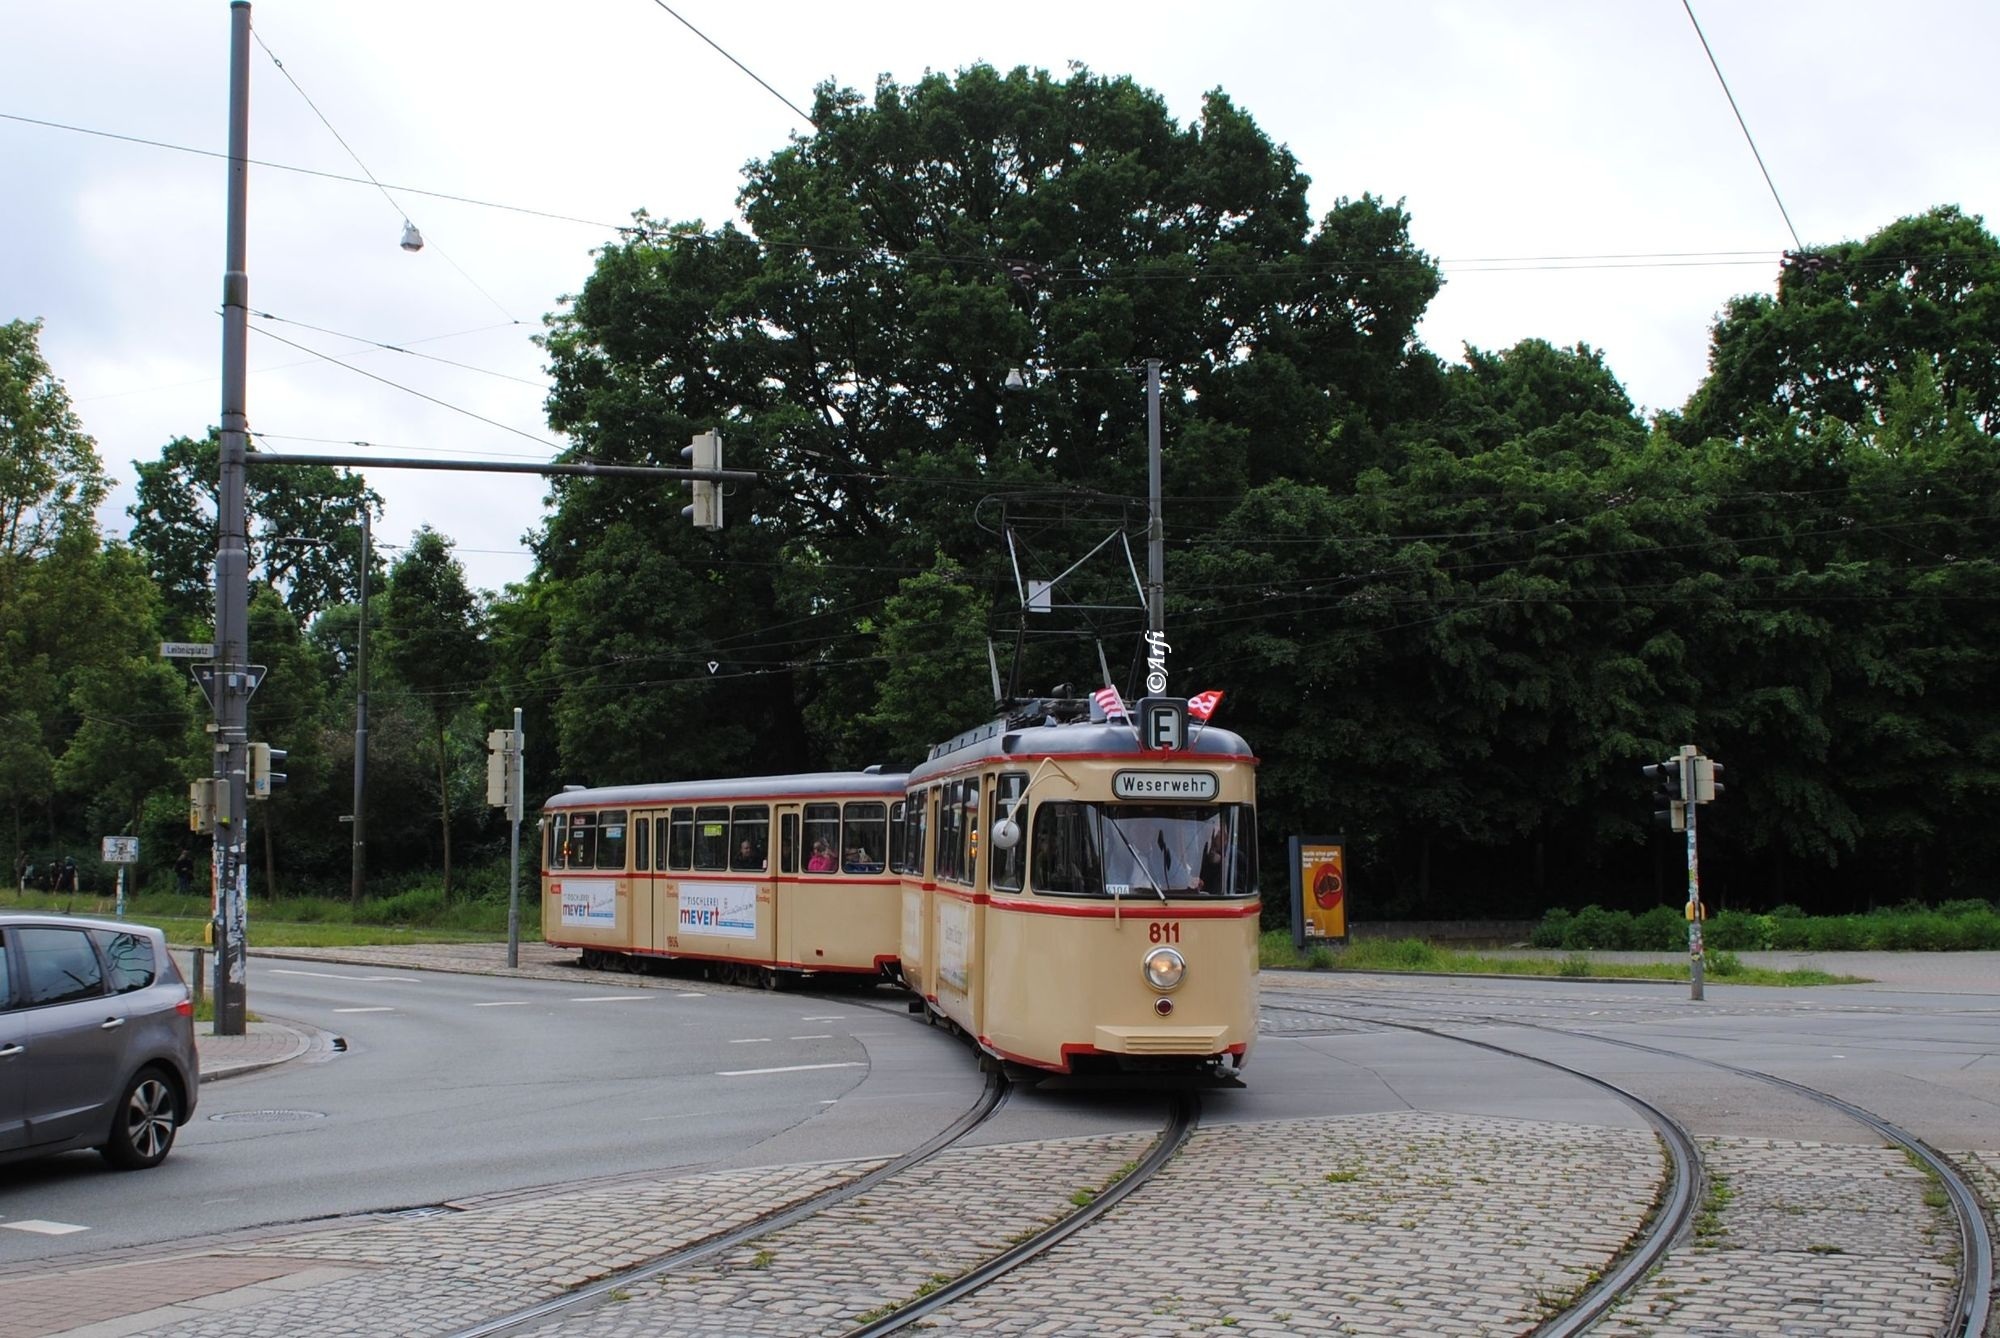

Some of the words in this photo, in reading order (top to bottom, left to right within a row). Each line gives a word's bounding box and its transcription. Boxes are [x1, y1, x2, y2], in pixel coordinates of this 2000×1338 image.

[167, 646, 208, 657] Leibnizplatz
[1154, 710, 1173, 747] E
[1123, 776, 1208, 792] Weserwehr
[687, 896, 719, 907] TISCHLEREI
[1149, 922, 1180, 944] 811
